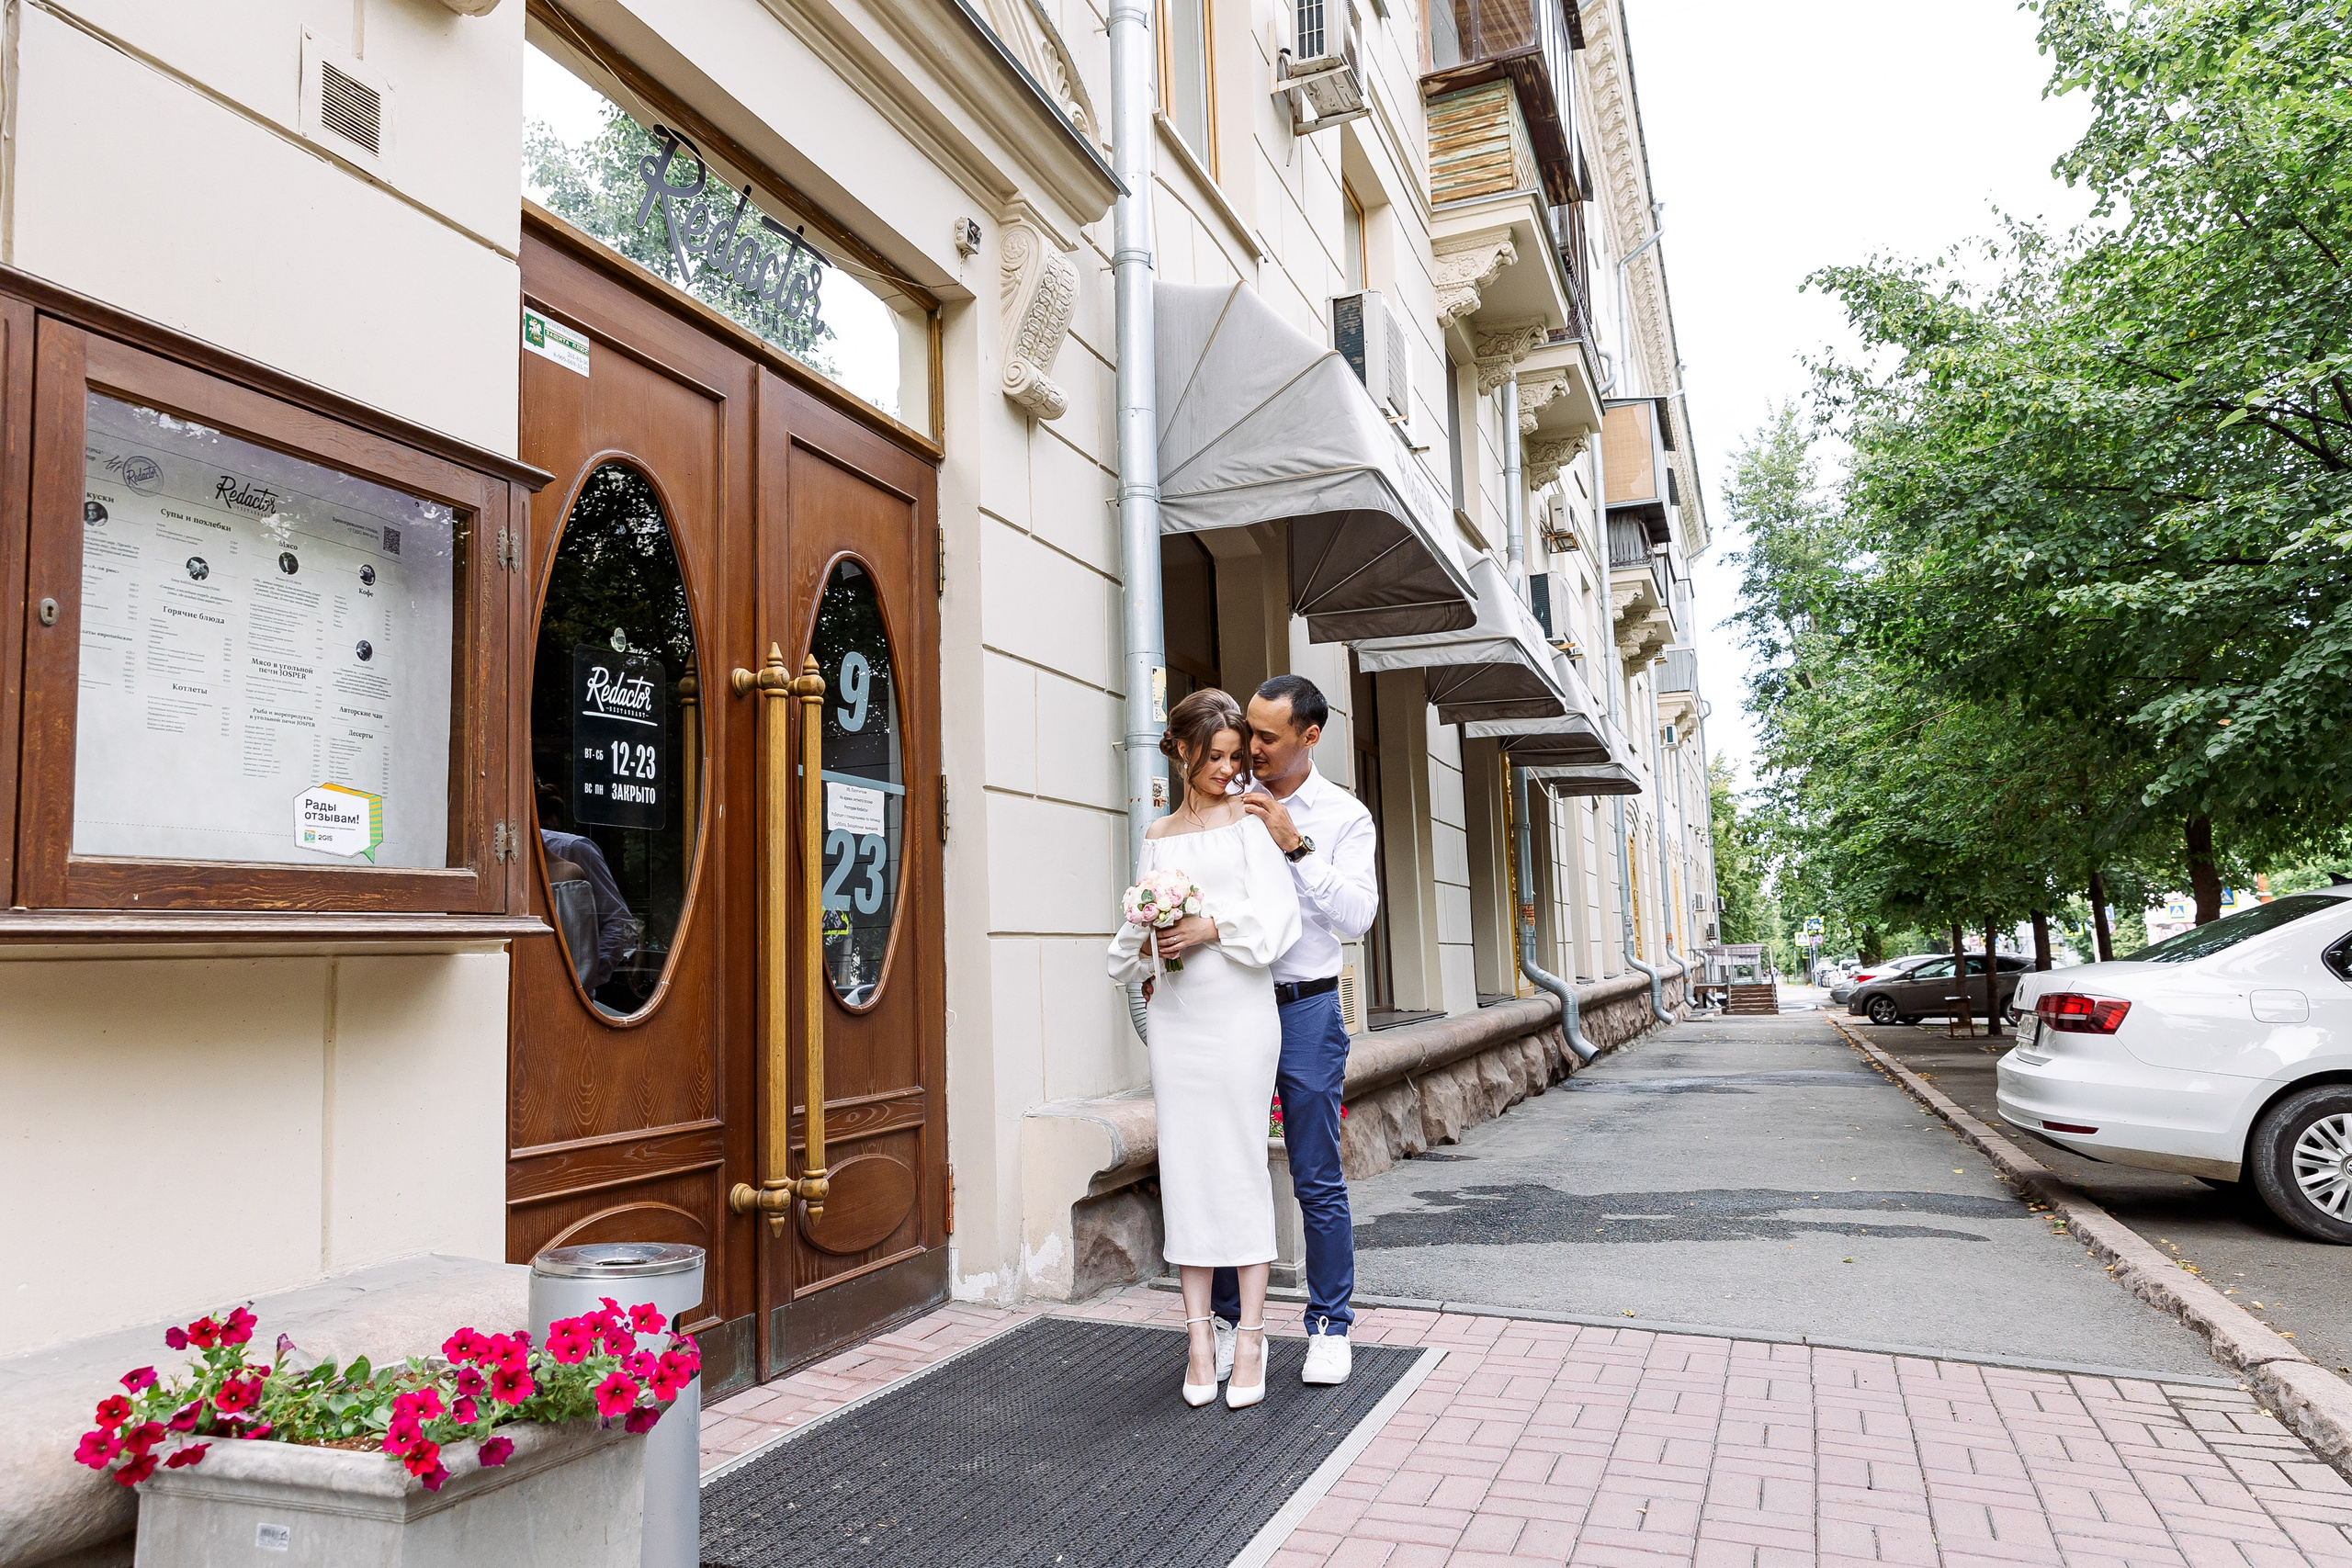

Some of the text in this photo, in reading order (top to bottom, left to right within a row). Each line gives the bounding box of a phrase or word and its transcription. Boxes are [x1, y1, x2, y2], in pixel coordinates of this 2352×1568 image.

[636, 124, 832, 335] Redactor
[126, 465, 158, 485] Redactor
[215, 475, 279, 514] Redactor
[160, 508, 183, 519] Супы
[193, 518, 231, 532] похлебки
[279, 540, 298, 550] Мясо
[359, 588, 373, 598] Кофе
[163, 605, 225, 625] Горячие блюда
[251, 658, 271, 667] Мясо
[279, 663, 313, 674] угольной
[279, 669, 307, 680] JOSPER
[172, 683, 207, 694] Котлеты
[586, 666, 654, 712] Redactor
[837, 651, 870, 732] 9
[274, 711, 313, 721] морепродукты
[339, 706, 371, 717] Авторские
[348, 729, 373, 739] Десерты
[611, 741, 656, 779] 12-23
[585, 783, 656, 804] ВС ПН ЗАКРЫТО
[305, 799, 336, 812] Рады
[304, 812, 360, 824] отзывам!
[822, 828, 886, 914] 23
